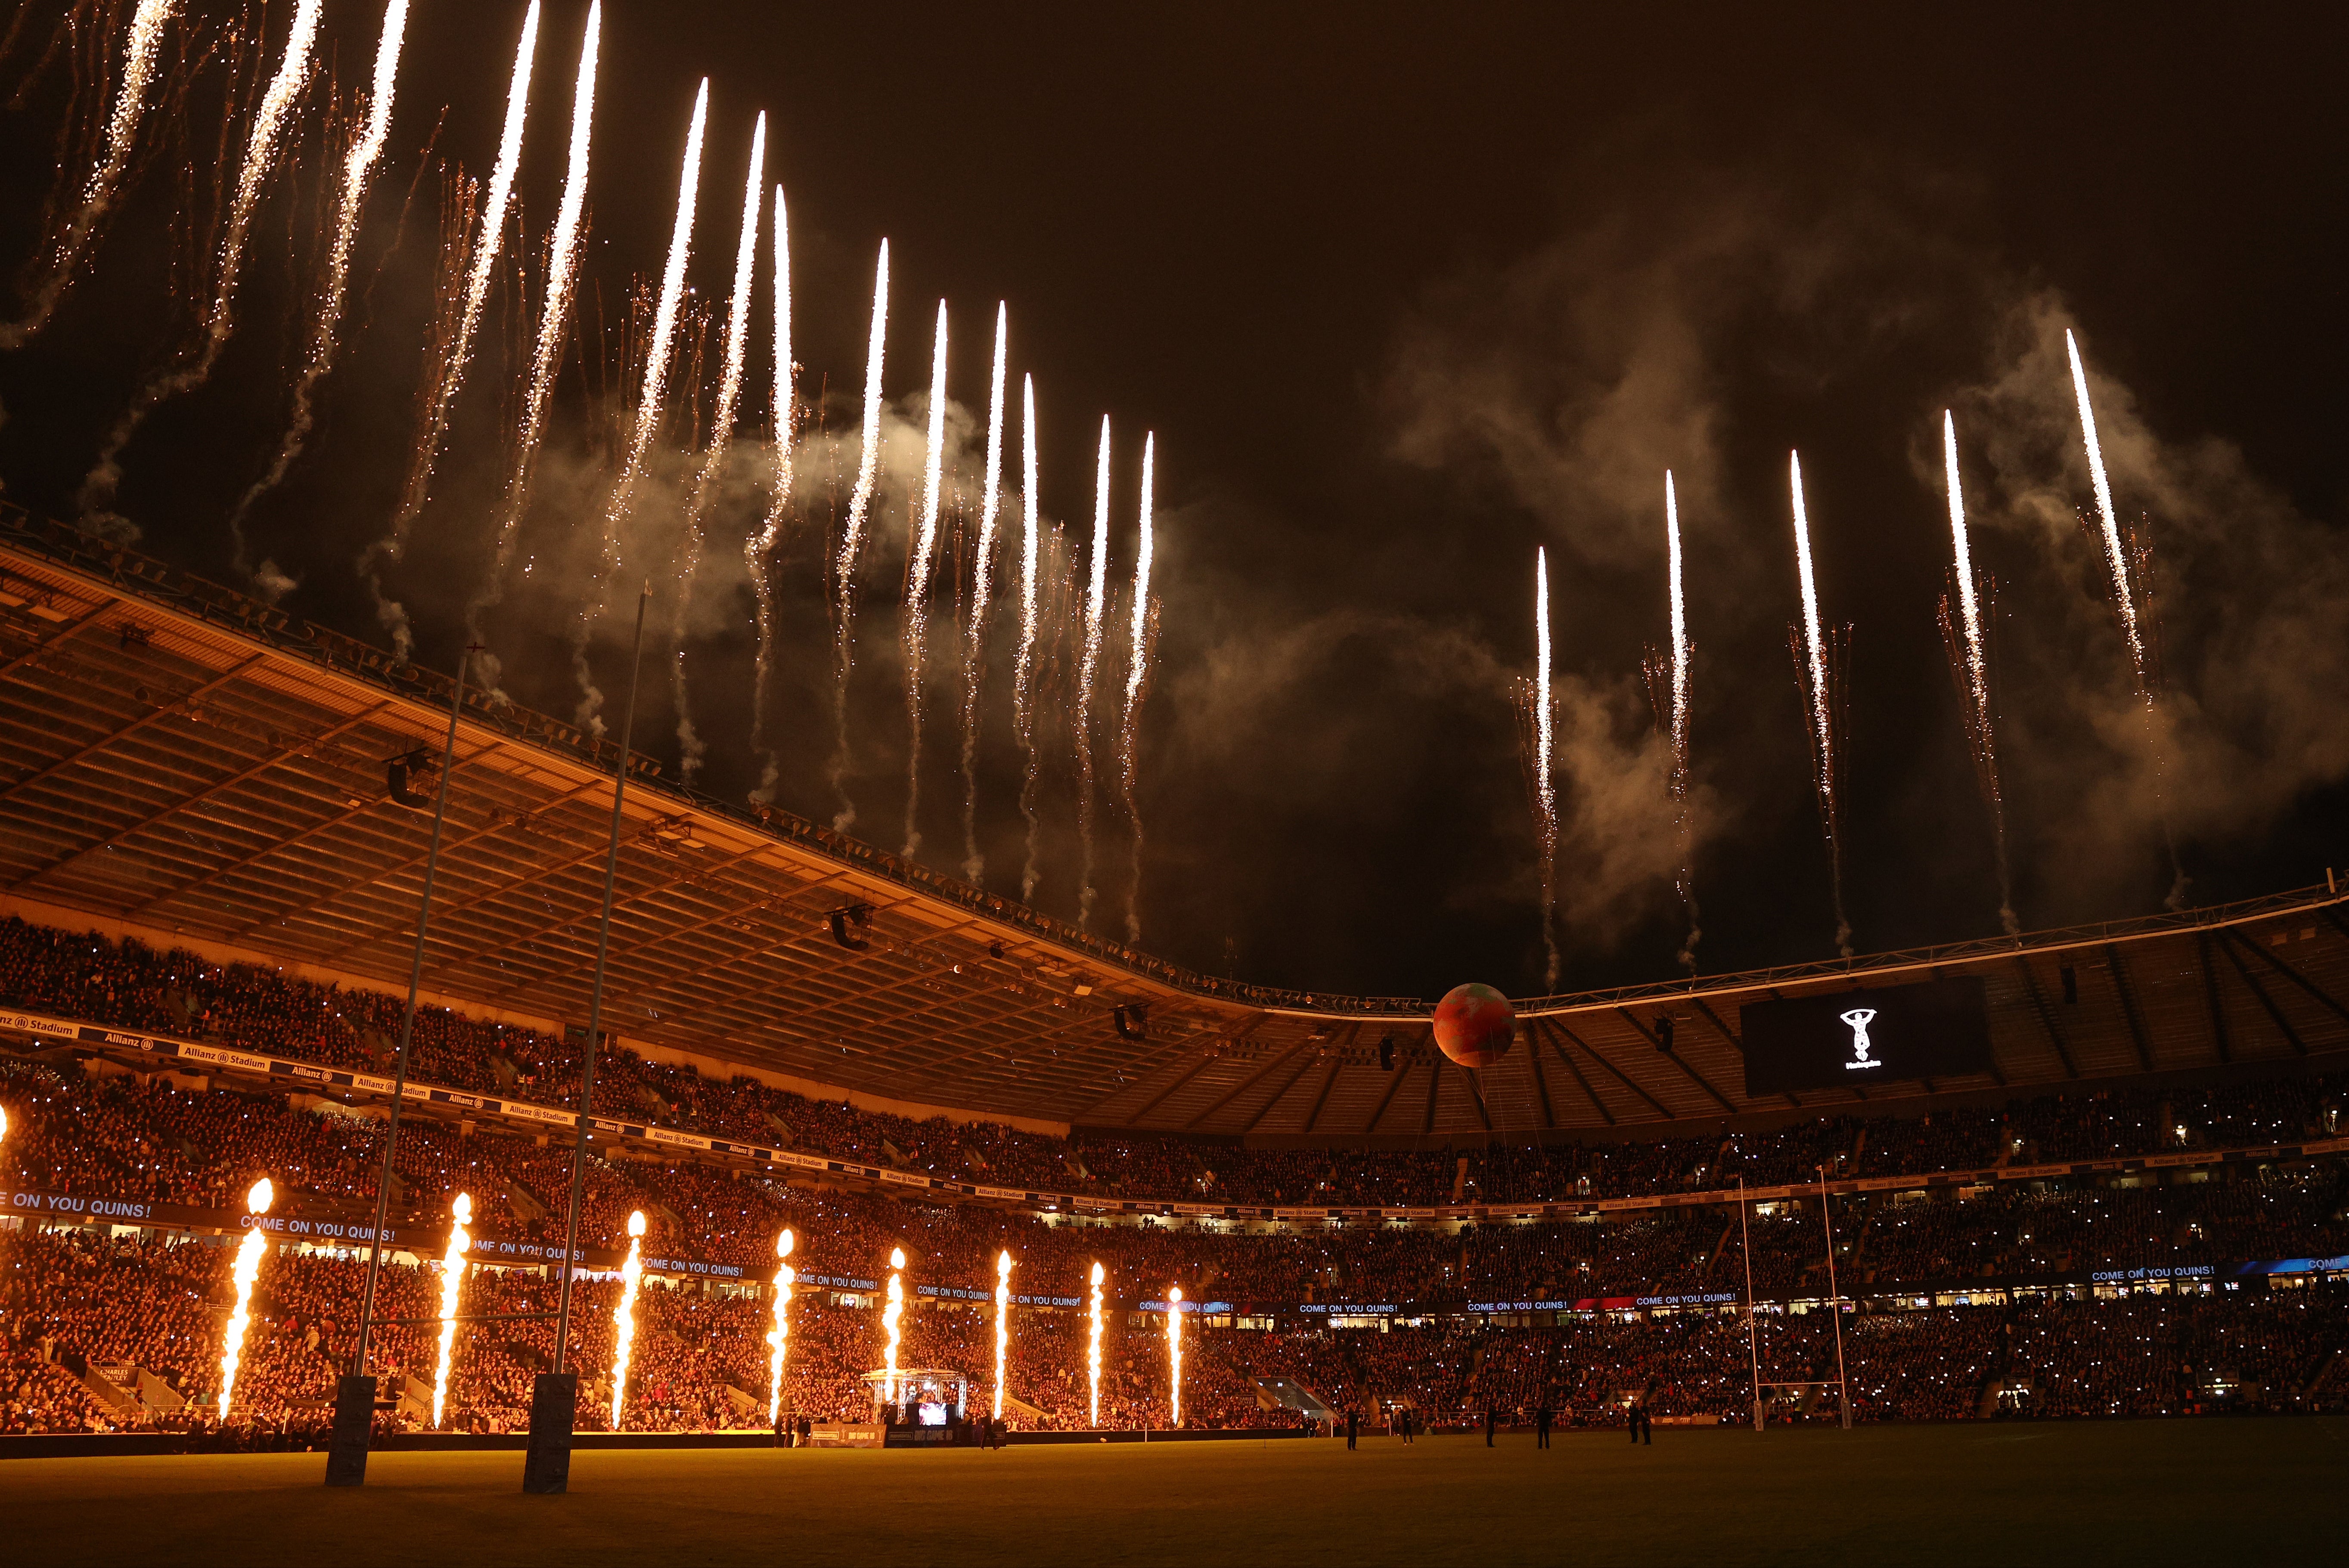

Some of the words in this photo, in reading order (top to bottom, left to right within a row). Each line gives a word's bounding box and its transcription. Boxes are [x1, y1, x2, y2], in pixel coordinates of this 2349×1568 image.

[30, 1020, 72, 1035] Stadium
[105, 1033, 139, 1047] Allianz
[185, 1047, 215, 1060] Allianz
[230, 1055, 265, 1068] Stadium
[292, 1066, 320, 1078] Allianz
[358, 1078, 384, 1089] Allianz
[402, 1086, 425, 1097] tadium
[449, 1094, 473, 1105] Allianz
[509, 1105, 531, 1116] Allianz
[543, 1112, 568, 1122] Stadium
[595, 1121, 616, 1131] Allianz
[654, 1131, 673, 1140] Allianz
[682, 1137, 704, 1146] Stadium
[729, 1145, 747, 1154] Allianz
[779, 1154, 795, 1162] Allianz
[803, 1159, 822, 1167] Stadium
[13, 1193, 40, 1208] ON
[48, 1196, 85, 1212] YOU
[90, 1200, 151, 1218] QUINS!
[241, 1215, 284, 1230] COME
[289, 1221, 310, 1233] ON
[315, 1223, 344, 1236] YOU
[500, 1242, 515, 1253] ON
[546, 1247, 585, 1261] QUIS!
[639, 1257, 668, 1269] COME
[671, 1260, 685, 1271] ON
[689, 1262, 707, 1273] YOU
[711, 1264, 743, 1277] QUINS!
[2092, 1271, 2125, 1281] COME
[2128, 1269, 2144, 1278] ON
[2147, 1268, 2171, 1277] YOU
[2175, 1266, 2215, 1276] QUINS!
[818, 1276, 829, 1286] ON
[832, 1277, 848, 1287] YOU
[850, 1279, 878, 1290] QUINS!
[918, 1286, 938, 1295] COME
[940, 1287, 951, 1296] ON
[952, 1289, 966, 1298] YOU
[968, 1290, 991, 1301] QUINS!
[1703, 1293, 1736, 1302] QUINS!
[1018, 1295, 1030, 1304] ON
[1033, 1296, 1050, 1305] YOU
[1052, 1297, 1080, 1307] QUINS!
[1139, 1302, 1164, 1310] COME
[1183, 1303, 1200, 1312] YOU
[1535, 1301, 1567, 1310] QUINS!
